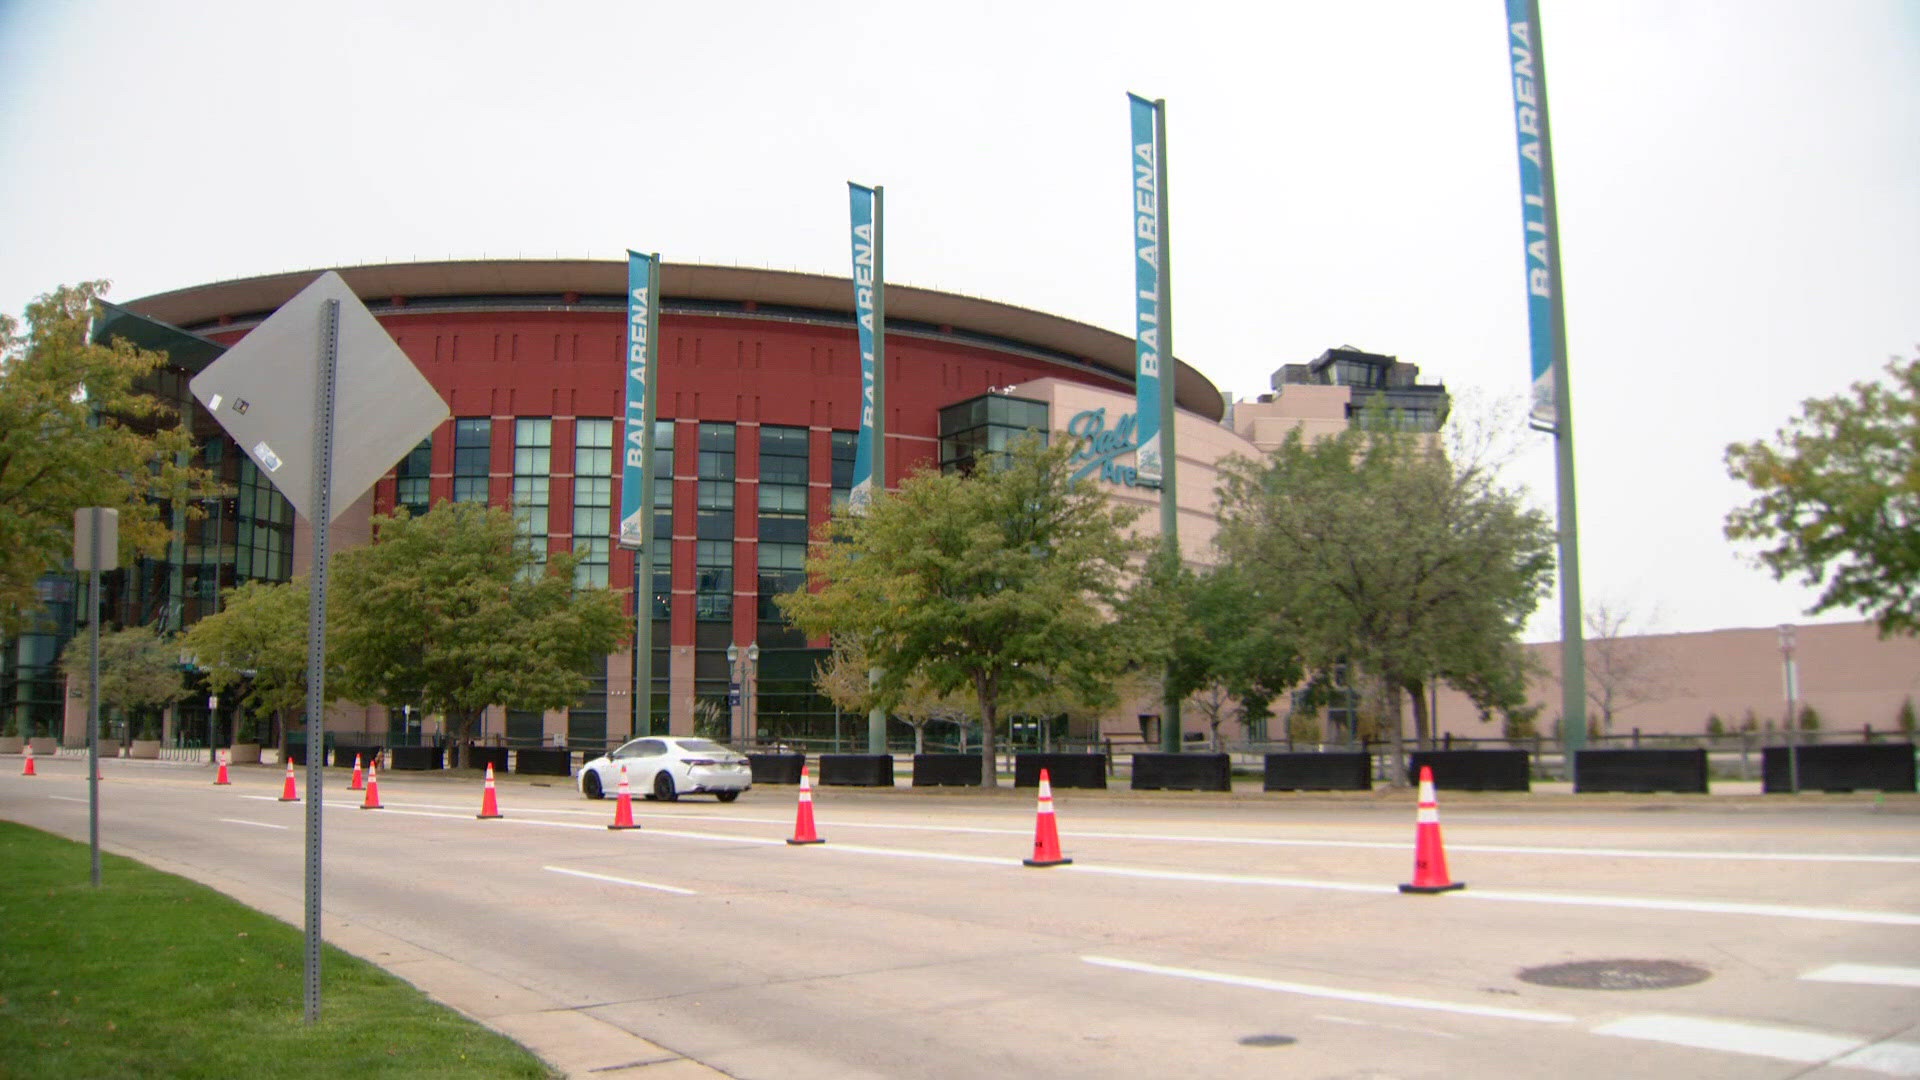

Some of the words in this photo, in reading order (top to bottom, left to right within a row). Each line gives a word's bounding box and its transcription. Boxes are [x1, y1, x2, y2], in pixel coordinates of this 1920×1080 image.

[1510, 20, 1542, 167] ARENA
[1135, 142, 1158, 269] ARENA
[854, 223, 873, 332] ARENA
[630, 287, 648, 387] ARENA
[1140, 282, 1161, 378] BALL
[626, 395, 645, 468] BALL
[1068, 407, 1137, 464] Ball
[1100, 460, 1137, 488] Are
